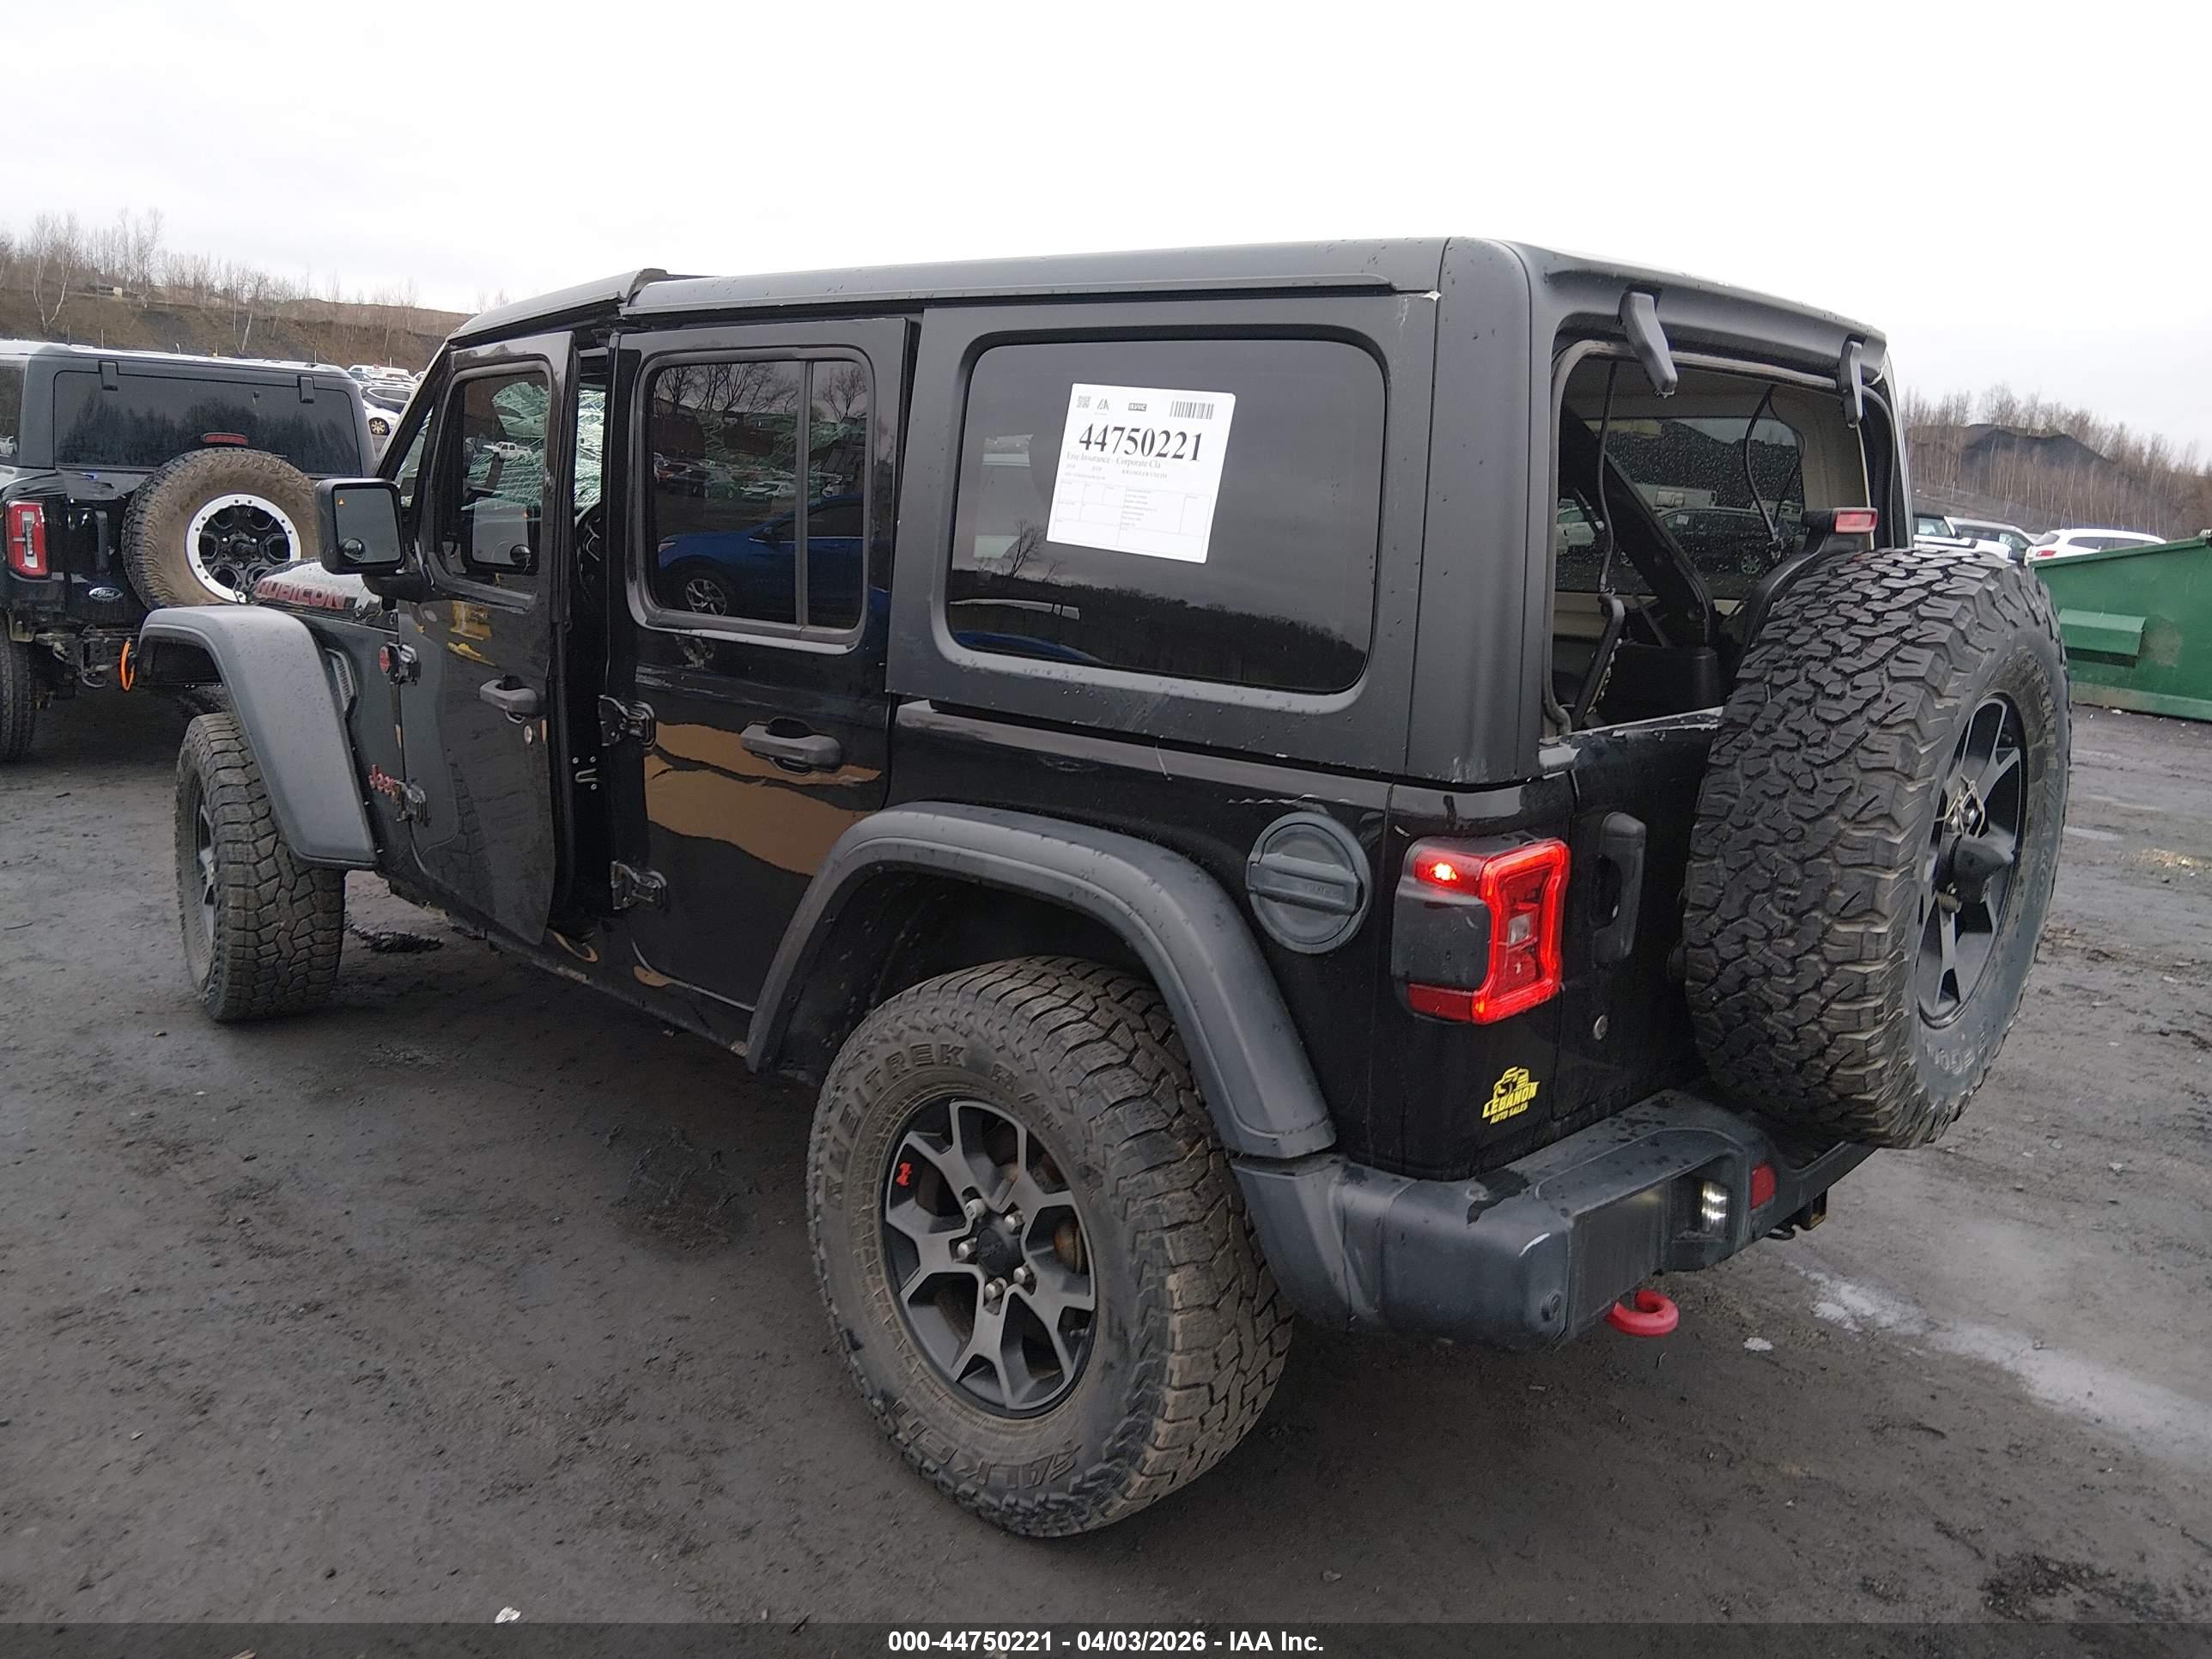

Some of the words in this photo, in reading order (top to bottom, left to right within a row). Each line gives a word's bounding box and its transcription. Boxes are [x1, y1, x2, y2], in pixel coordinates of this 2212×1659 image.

[1079, 422, 1202, 462] 44750221
[1066, 452, 1080, 461] Erie
[1081, 453, 1111, 465] Insurance
[1116, 456, 1148, 468] Corporate
[257, 580, 344, 611] RUBICON
[368, 764, 399, 804] Jeep
[1482, 1081, 1540, 1119] LEBANON
[1490, 1109, 1509, 1126] AUTO
[1509, 1102, 1528, 1118] SALES
